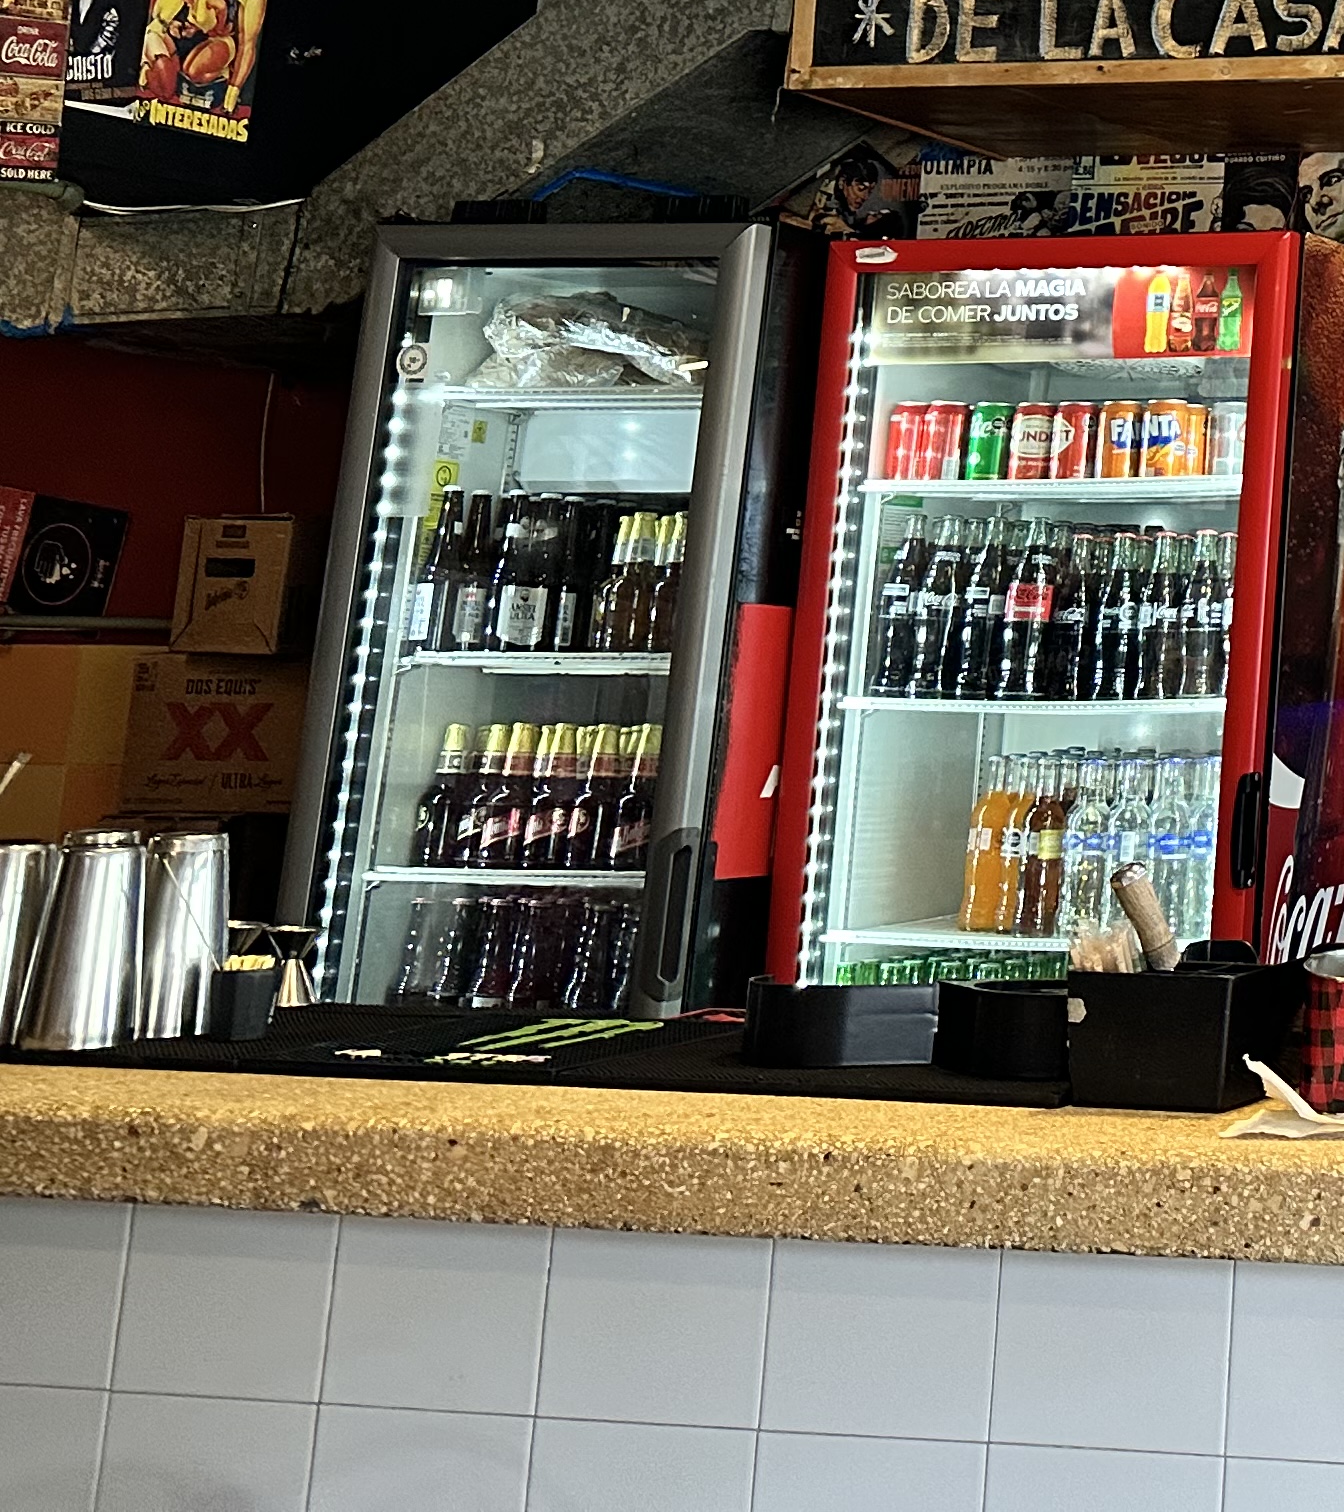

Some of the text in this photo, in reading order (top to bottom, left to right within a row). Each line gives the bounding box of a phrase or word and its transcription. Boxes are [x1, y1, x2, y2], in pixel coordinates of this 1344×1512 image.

[5, 122, 55, 134] ICE COLD
[149, 98, 249, 143] INTERESADAS
[0, 167, 53, 180] SOLD HERE
[886, 278, 1086, 300] SABOREA LA MAGIA
[886, 303, 1079, 325] DE COMER JUNTOS
[185, 677, 257, 696] DOS EQUIS
[158, 701, 275, 763] XX
[220, 773, 253, 789] ULTRA
